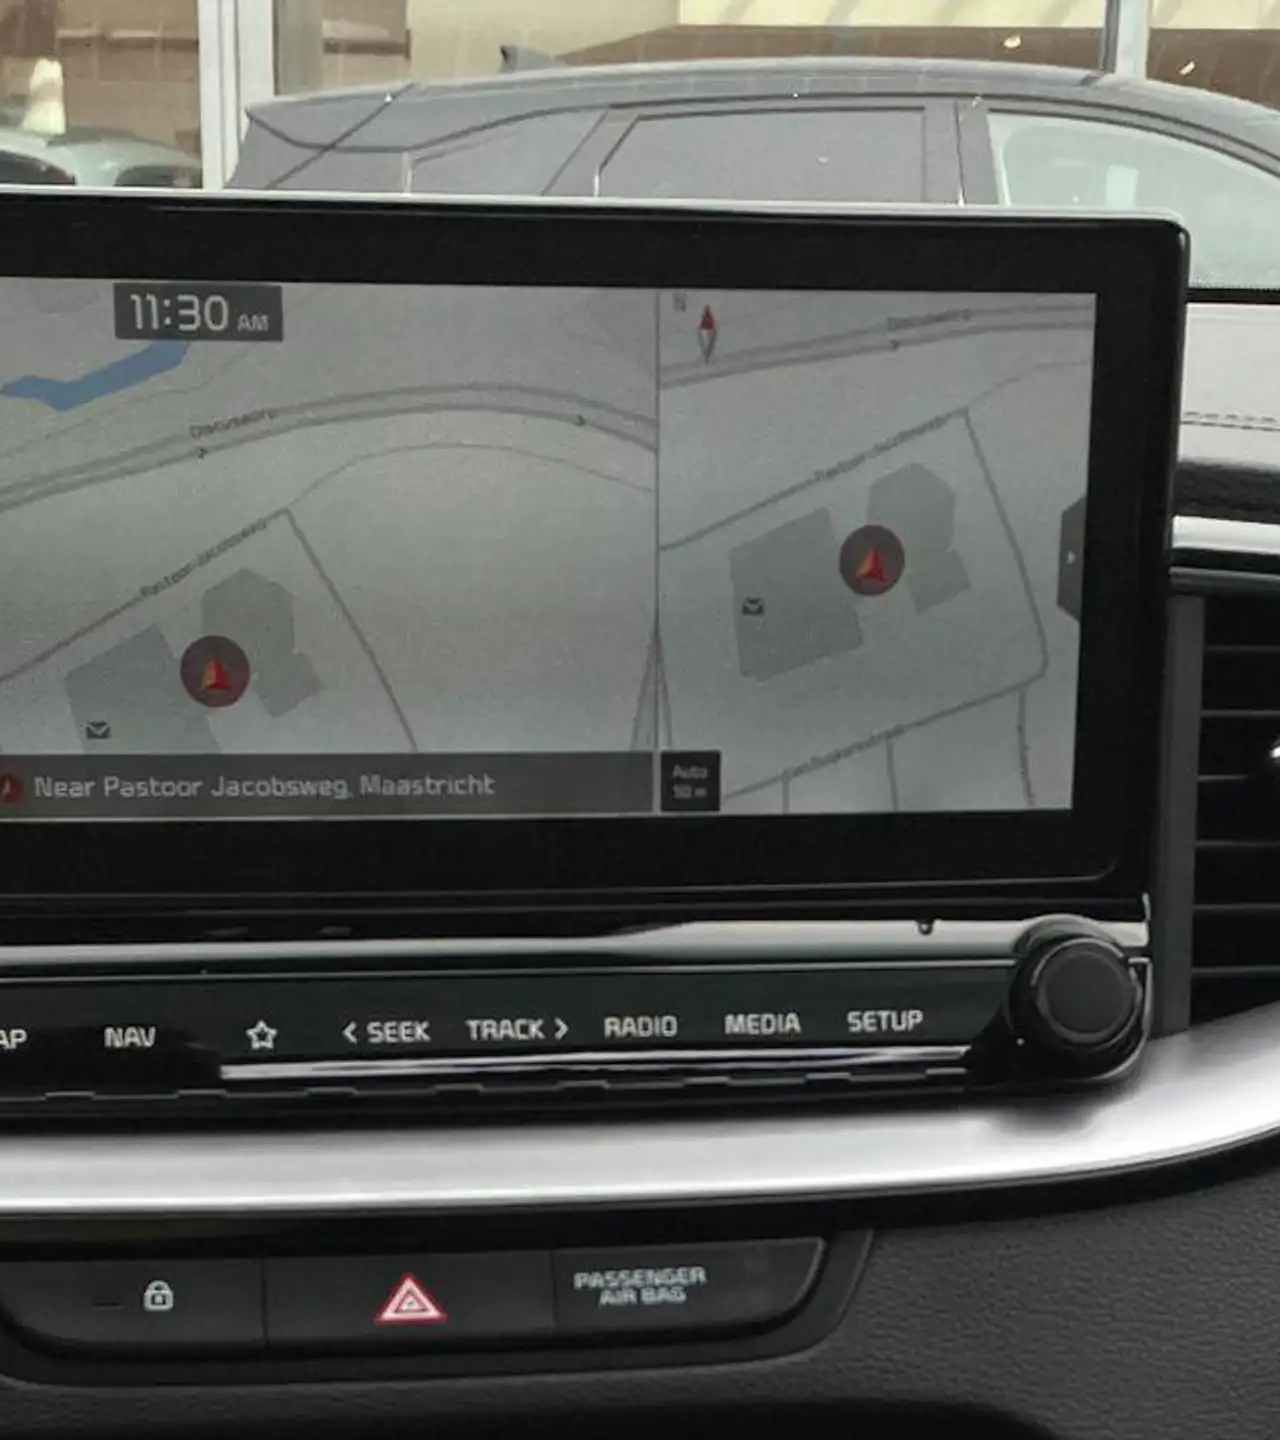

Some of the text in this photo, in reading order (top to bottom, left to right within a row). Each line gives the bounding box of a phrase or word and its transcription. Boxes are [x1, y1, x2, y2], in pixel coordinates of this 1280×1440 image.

[130, 293, 270, 332] 11:30 AM
[672, 763, 708, 780] Auto
[34, 772, 496, 800] Near Pastoor Jacobsweg, Maastricht
[366, 1020, 431, 1044] SEEK
[466, 1017, 546, 1041] TRACK
[603, 1015, 678, 1038] RADIO
[724, 1011, 802, 1036] MEDIA
[846, 1009, 924, 1033] SETUP
[104, 1026, 156, 1048] NAV
[573, 1265, 708, 1290] PASSENGER
[597, 1285, 687, 1308] AIR BAG
